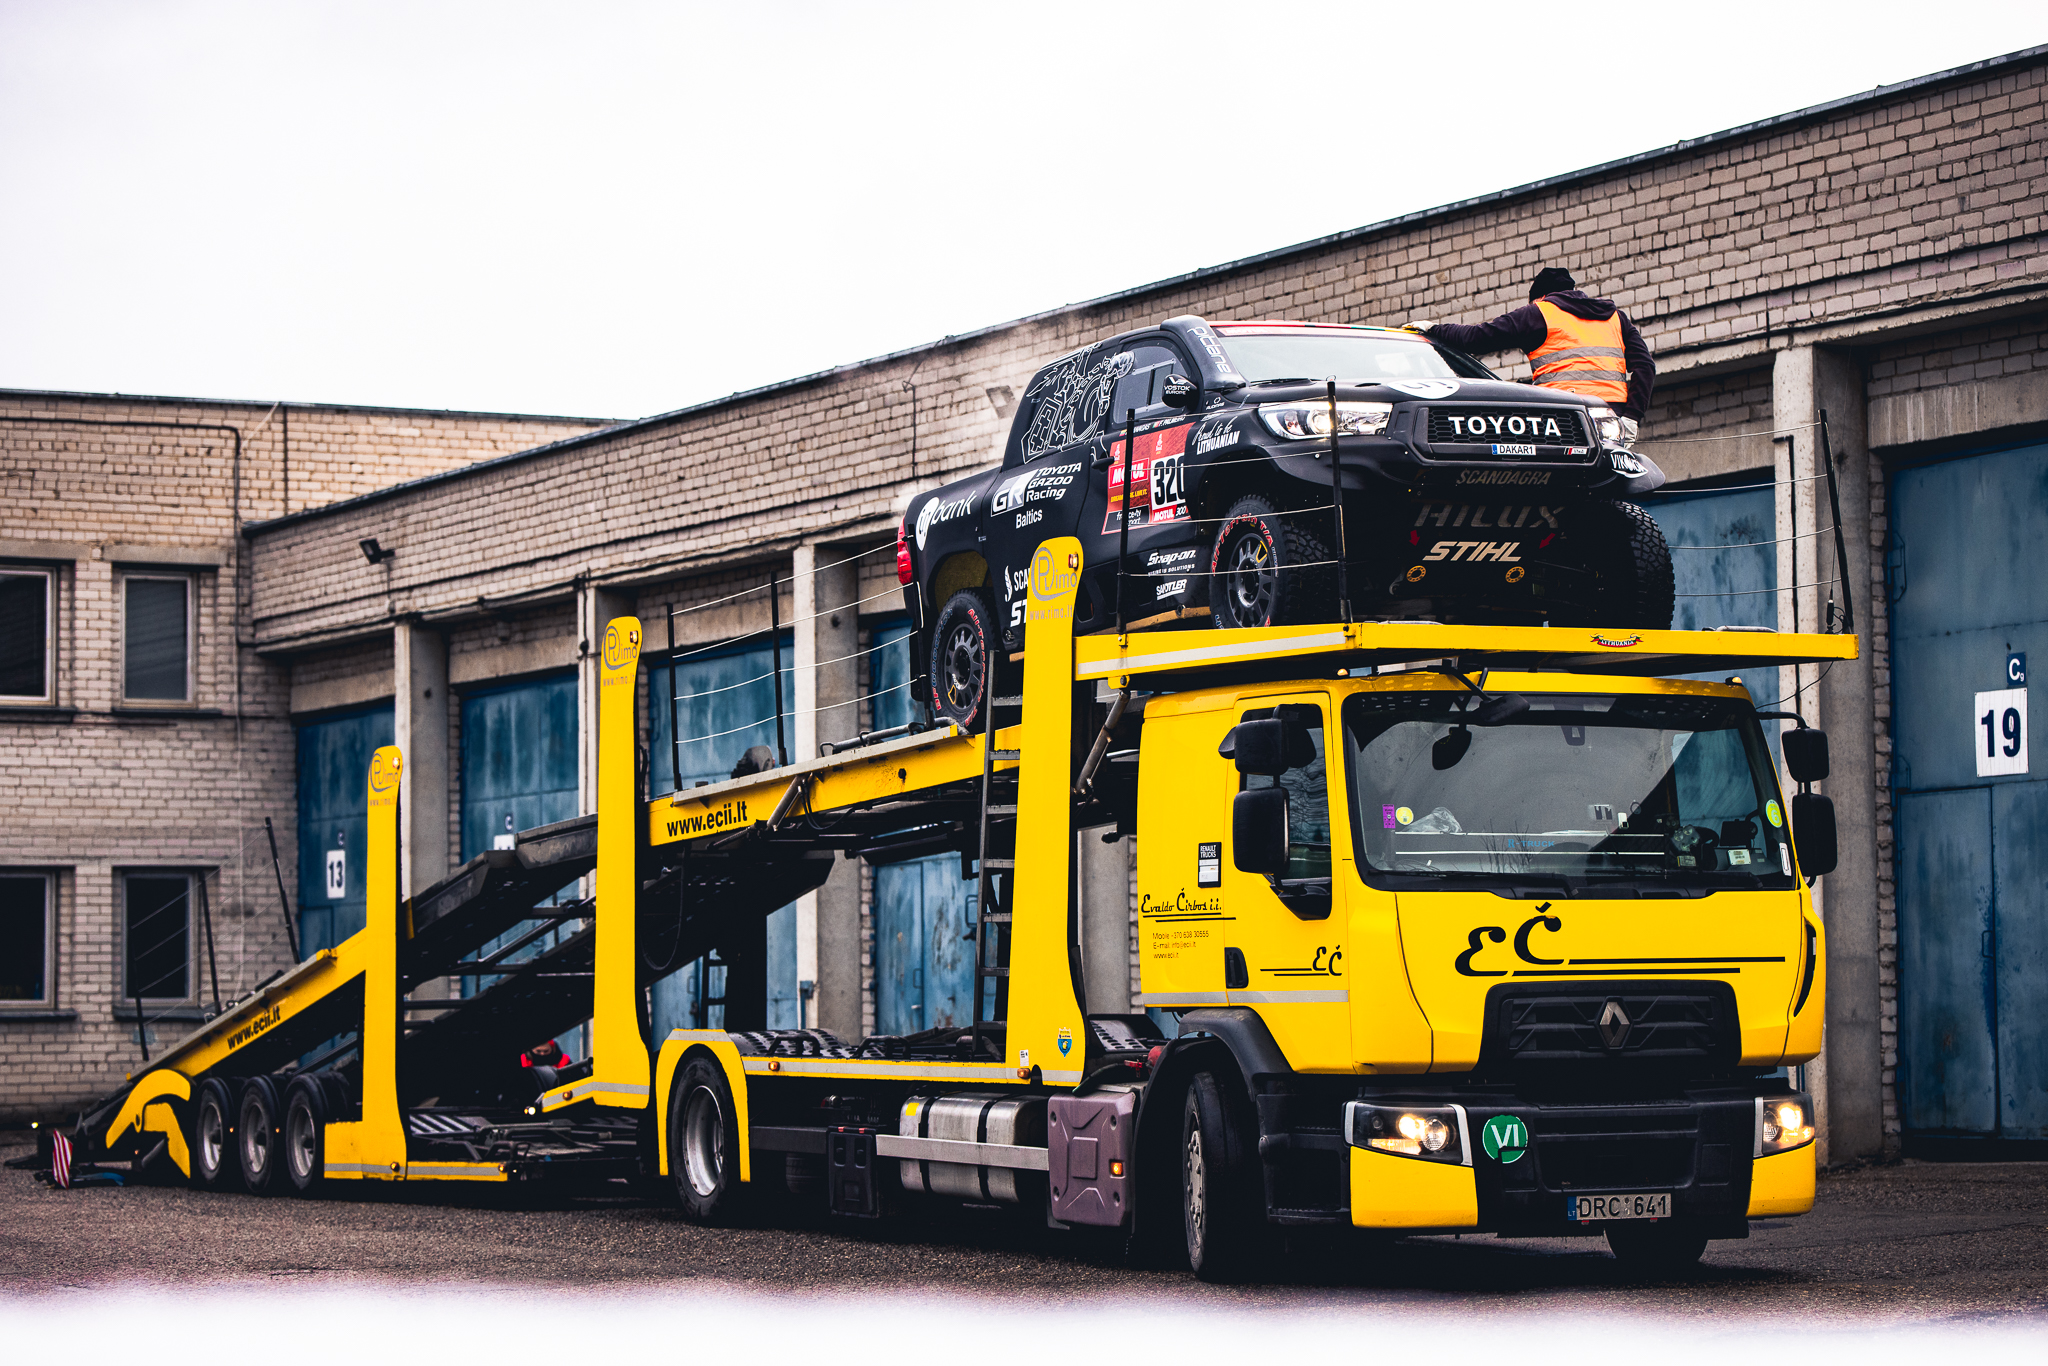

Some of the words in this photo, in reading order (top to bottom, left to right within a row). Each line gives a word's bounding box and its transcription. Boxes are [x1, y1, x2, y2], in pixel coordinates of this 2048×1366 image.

[1448, 416, 1561, 436] TOYOTA
[1196, 430, 1240, 455] LITHUANIAN
[1499, 445, 1533, 454] DAKAR1
[1037, 462, 1082, 477] TOYOTA
[1456, 468, 1551, 485] SCANDAGRA
[1028, 476, 1073, 489] GAZOO
[992, 482, 1026, 513] GR
[1026, 488, 1066, 502] Racing
[1015, 509, 1042, 529] Baltics
[1154, 509, 1174, 521] MOTUL
[1414, 505, 1565, 528] HILUX
[1422, 541, 1521, 562] STIHL
[1030, 607, 1072, 621] www.rimo.lt
[1600, 638, 1636, 647] LITHUANIA
[1981, 708, 2021, 758] 19
[667, 801, 748, 837] www.ecii.lt
[1771, 809, 1779, 824] 6
[1507, 839, 1555, 848] R-TRUCK
[328, 860, 343, 888] 13
[1141, 894, 1175, 913] Evaldo
[227, 1006, 281, 1050] www.ecii.lt
[1491, 1124, 1519, 1149] VI
[1580, 1197, 1620, 1217] DRC
[1634, 1195, 1666, 1216] 641
